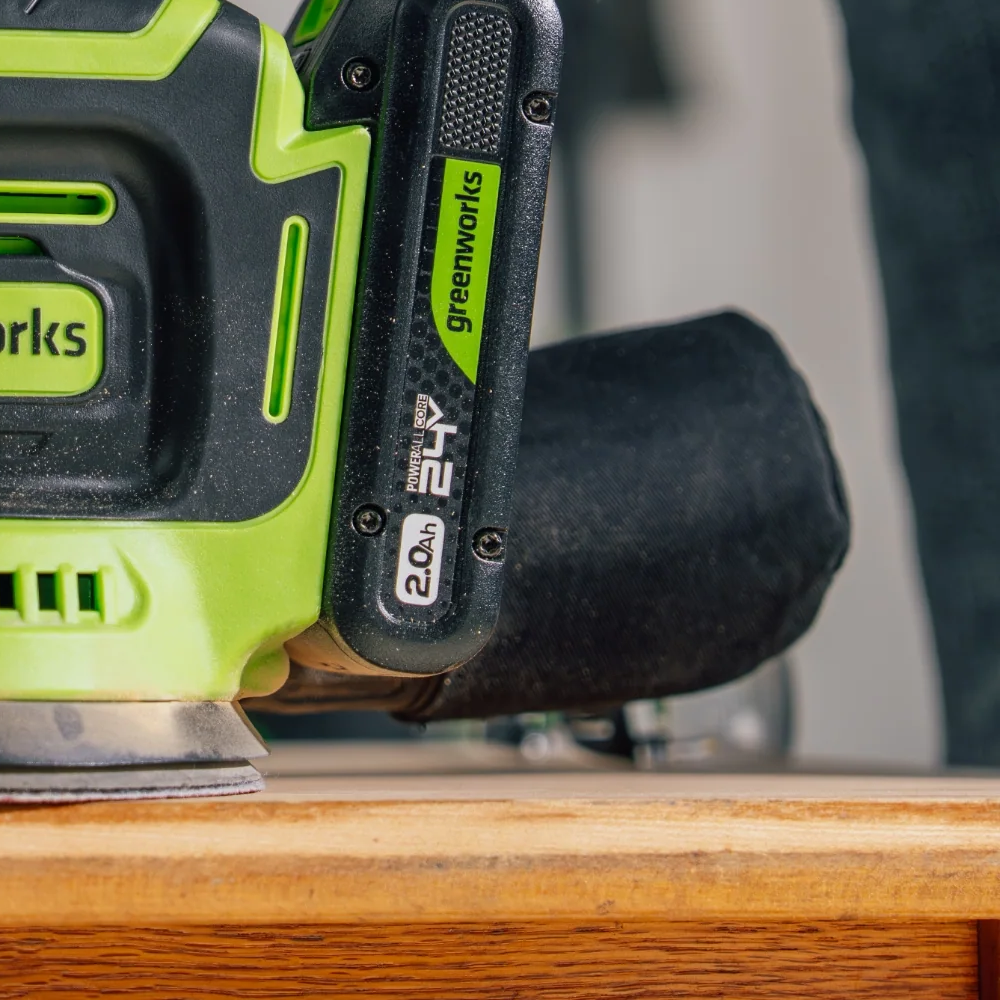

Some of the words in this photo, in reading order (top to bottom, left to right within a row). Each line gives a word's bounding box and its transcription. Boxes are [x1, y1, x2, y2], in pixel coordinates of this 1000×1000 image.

[446, 170, 483, 333] greenworks
[418, 396, 457, 497] 24V
[405, 522, 437, 598] 2.0Ah
